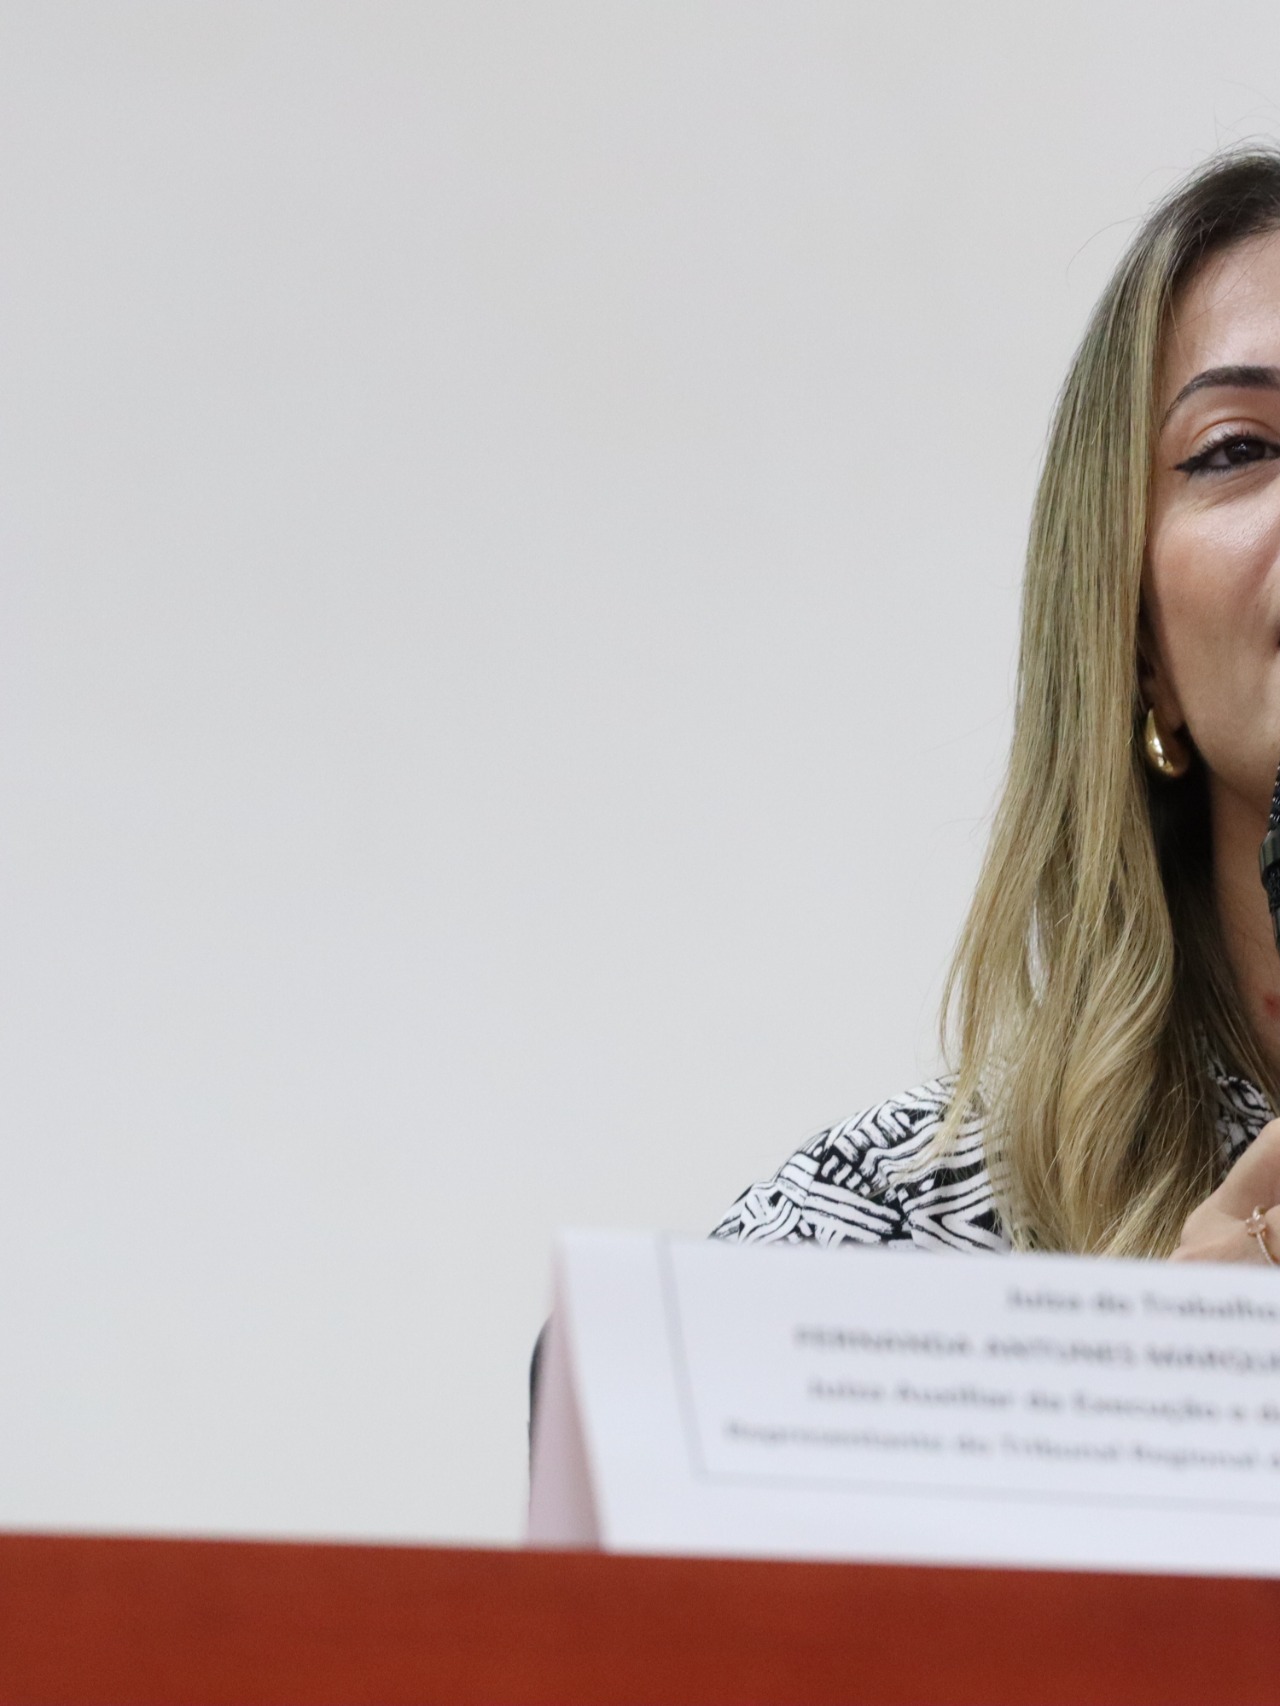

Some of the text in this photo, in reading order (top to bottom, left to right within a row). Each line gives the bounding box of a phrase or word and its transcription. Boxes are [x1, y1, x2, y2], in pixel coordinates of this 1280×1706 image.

[794, 1327, 973, 1357] FERNANDA
[983, 1338, 1137, 1368] ANTUNES
[894, 1383, 1013, 1411] Auxiliar
[1071, 1391, 1221, 1423] Execução
[723, 1419, 946, 1452] Representante
[999, 1434, 1125, 1462] Tribunal
[1130, 1443, 1260, 1472] Regional
